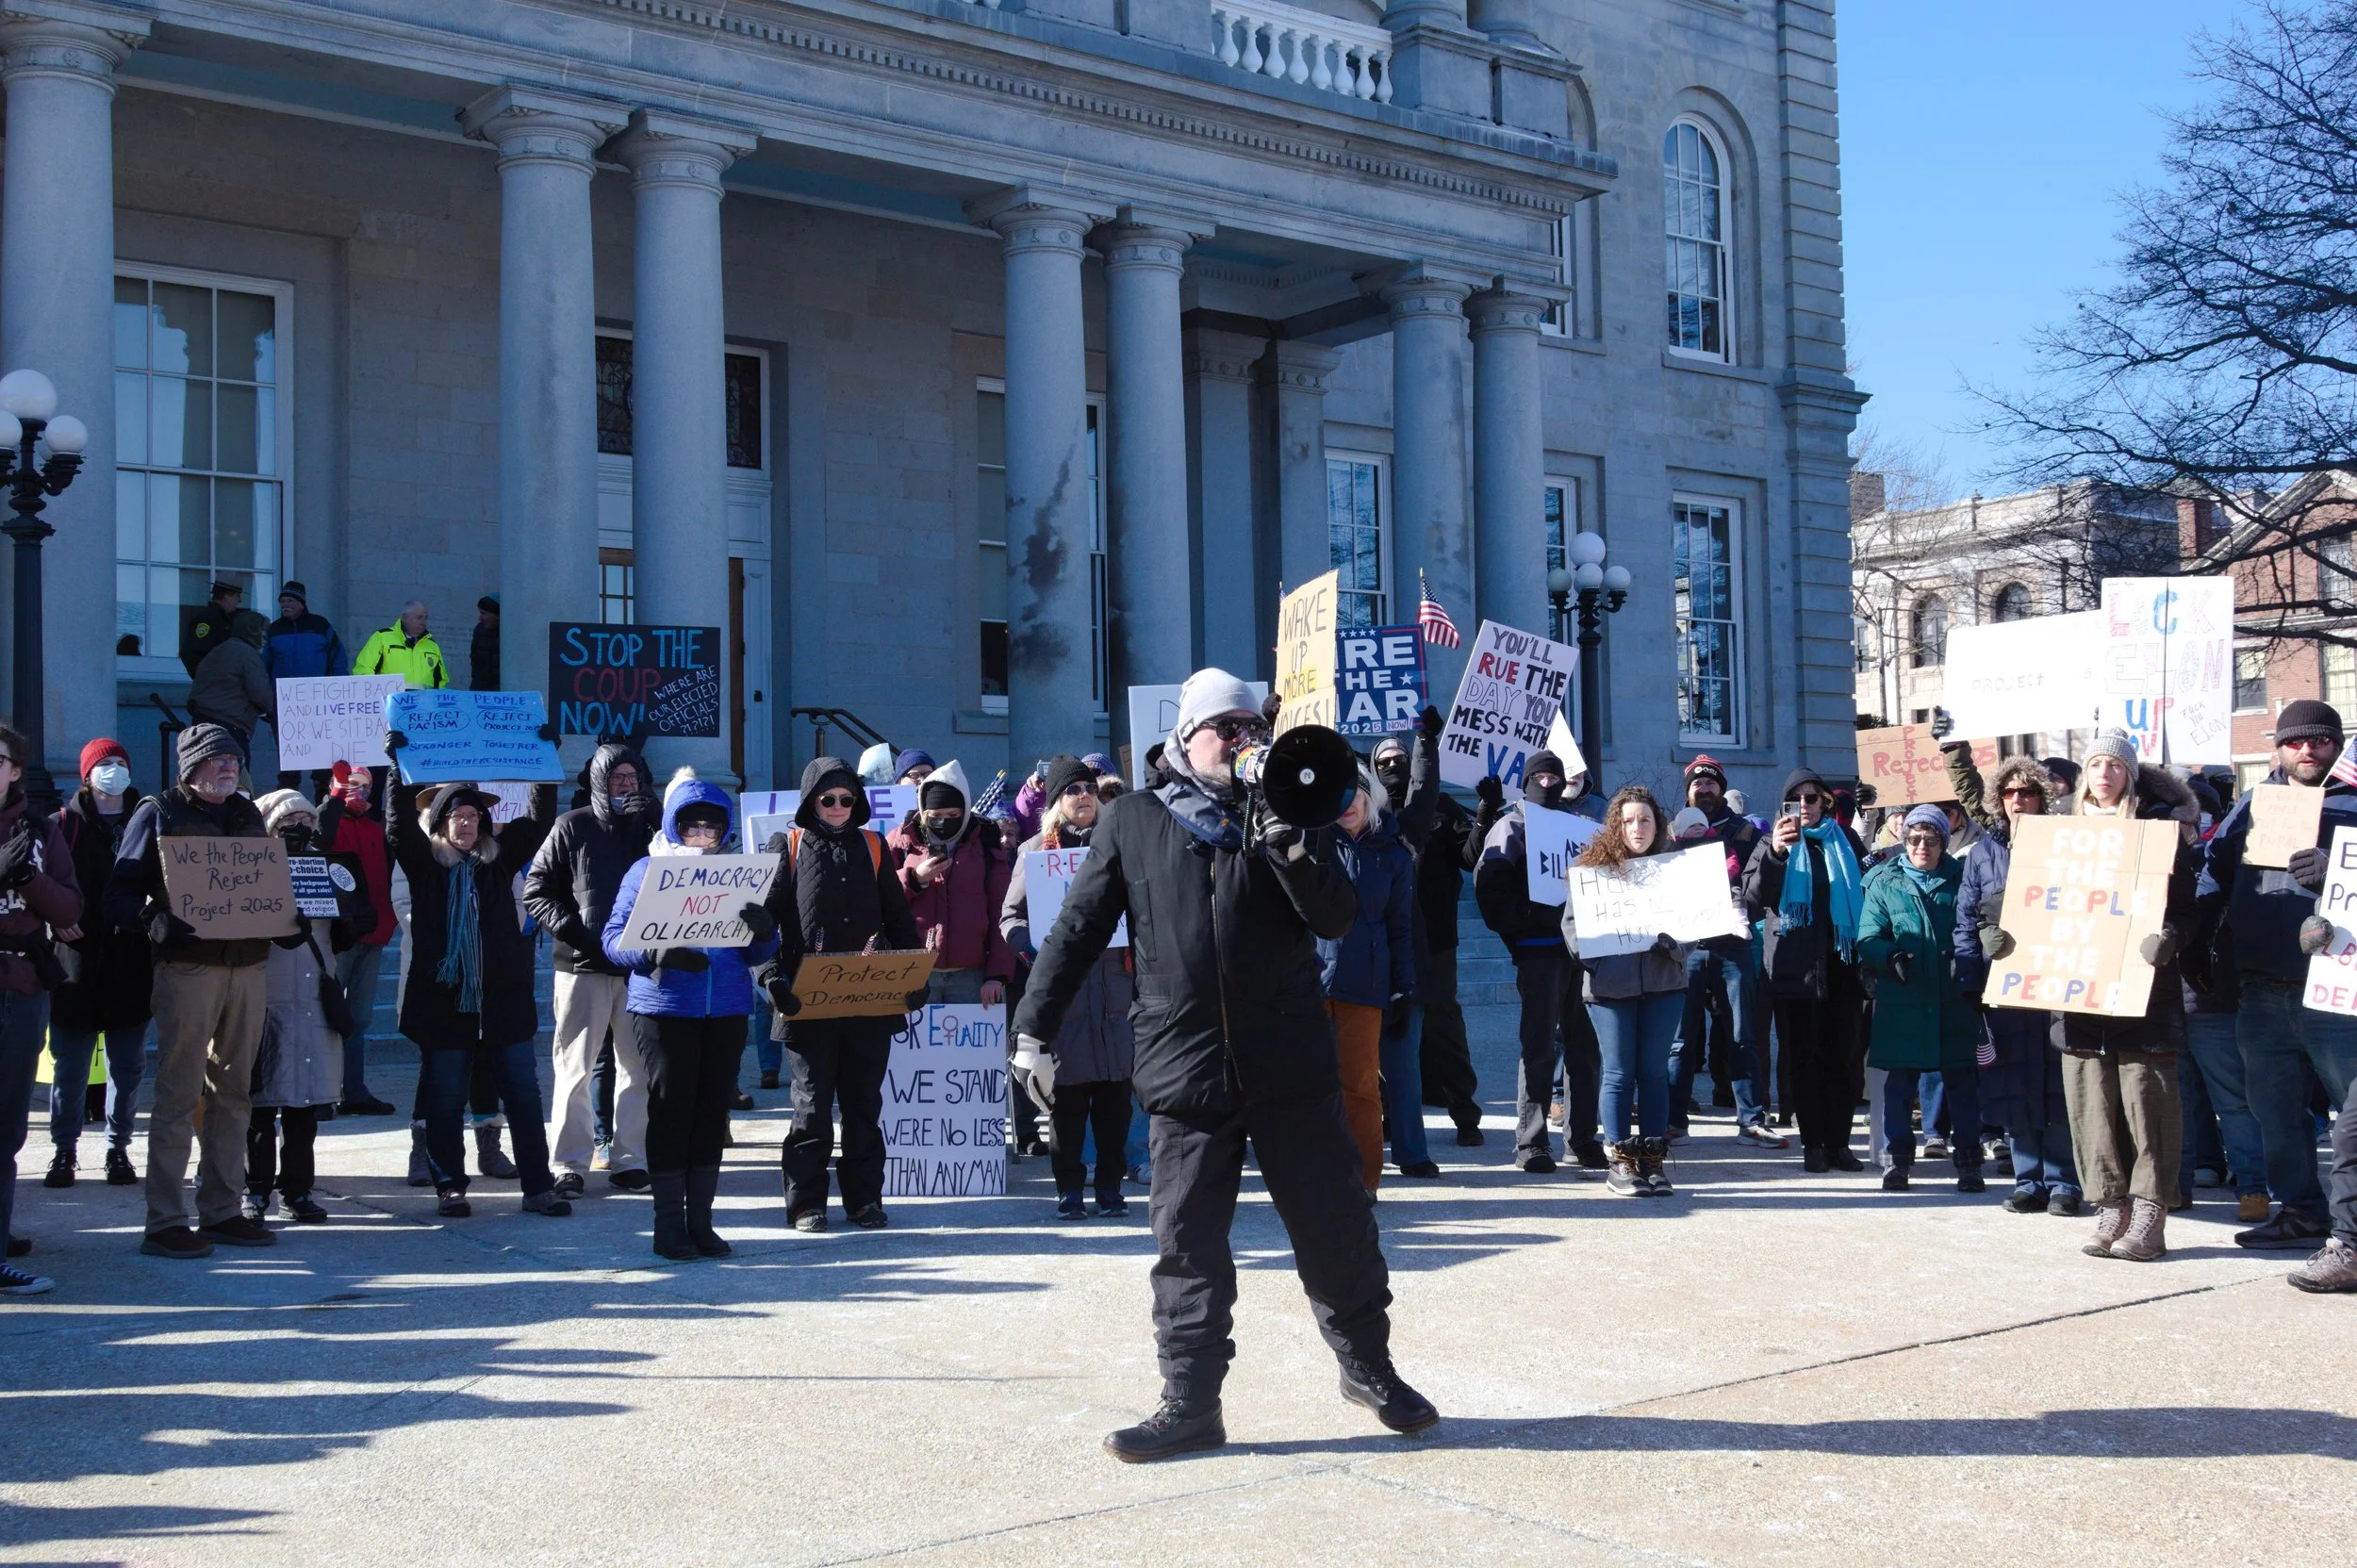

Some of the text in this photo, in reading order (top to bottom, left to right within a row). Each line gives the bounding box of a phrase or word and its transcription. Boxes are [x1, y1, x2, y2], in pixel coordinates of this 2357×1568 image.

[1284, 587, 1327, 643] WAKE
[560, 627, 704, 668] STOP THE
[1292, 640, 1309, 674] UP
[1335, 635, 1415, 670] RE
[1493, 627, 1552, 665] YOU'LL
[1335, 669, 1393, 691] HE
[1477, 652, 1567, 701] RUE THE
[2104, 638, 2225, 695] ELON
[280, 680, 403, 701] WE FIGHT BACK
[573, 668, 662, 705] COUP
[654, 665, 717, 701] WHERE ARE
[1283, 668, 1316, 703] MORE
[284, 701, 380, 718] AND LIVE FREE
[392, 694, 526, 705] WE THE PEOPLE
[649, 682, 718, 722] OUR ELECTED
[1335, 689, 1420, 724] AR
[1465, 675, 1558, 726] DAY YOU
[281, 717, 390, 740] OR WE SIT BA
[408, 711, 460, 723] REJECT
[408, 720, 458, 732] FACISM
[483, 712, 531, 721] REJECT
[484, 722, 521, 731] PROJECT
[659, 699, 719, 733] OFFICIALS
[1453, 705, 1551, 751] MESS WITH
[2124, 697, 2175, 732] UP
[284, 741, 366, 765] AND DIE
[408, 740, 539, 751] STRONGER TOGETHER
[1448, 734, 1482, 758] THE
[2129, 733, 2158, 757] OW
[171, 841, 277, 867] We the People
[2052, 829, 2125, 856] FOR
[206, 867, 264, 891] Reject
[658, 867, 774, 894] DEMOCRACY
[2044, 859, 2119, 888] THE
[181, 894, 284, 921] Project 2025
[680, 893, 730, 917] NOT
[2024, 885, 2150, 916] PEOPLE
[2050, 916, 2097, 941] BY
[819, 961, 919, 983] Protect
[2029, 945, 2101, 976] THE
[802, 990, 911, 1007] Democrac
[2002, 972, 2127, 1012] PEOPLE
[888, 1068, 1007, 1104] WE STAND
[882, 1117, 933, 1147] WERE
[973, 1117, 1006, 1147] LESS
[885, 1156, 1005, 1196] THAN ANY MAN
